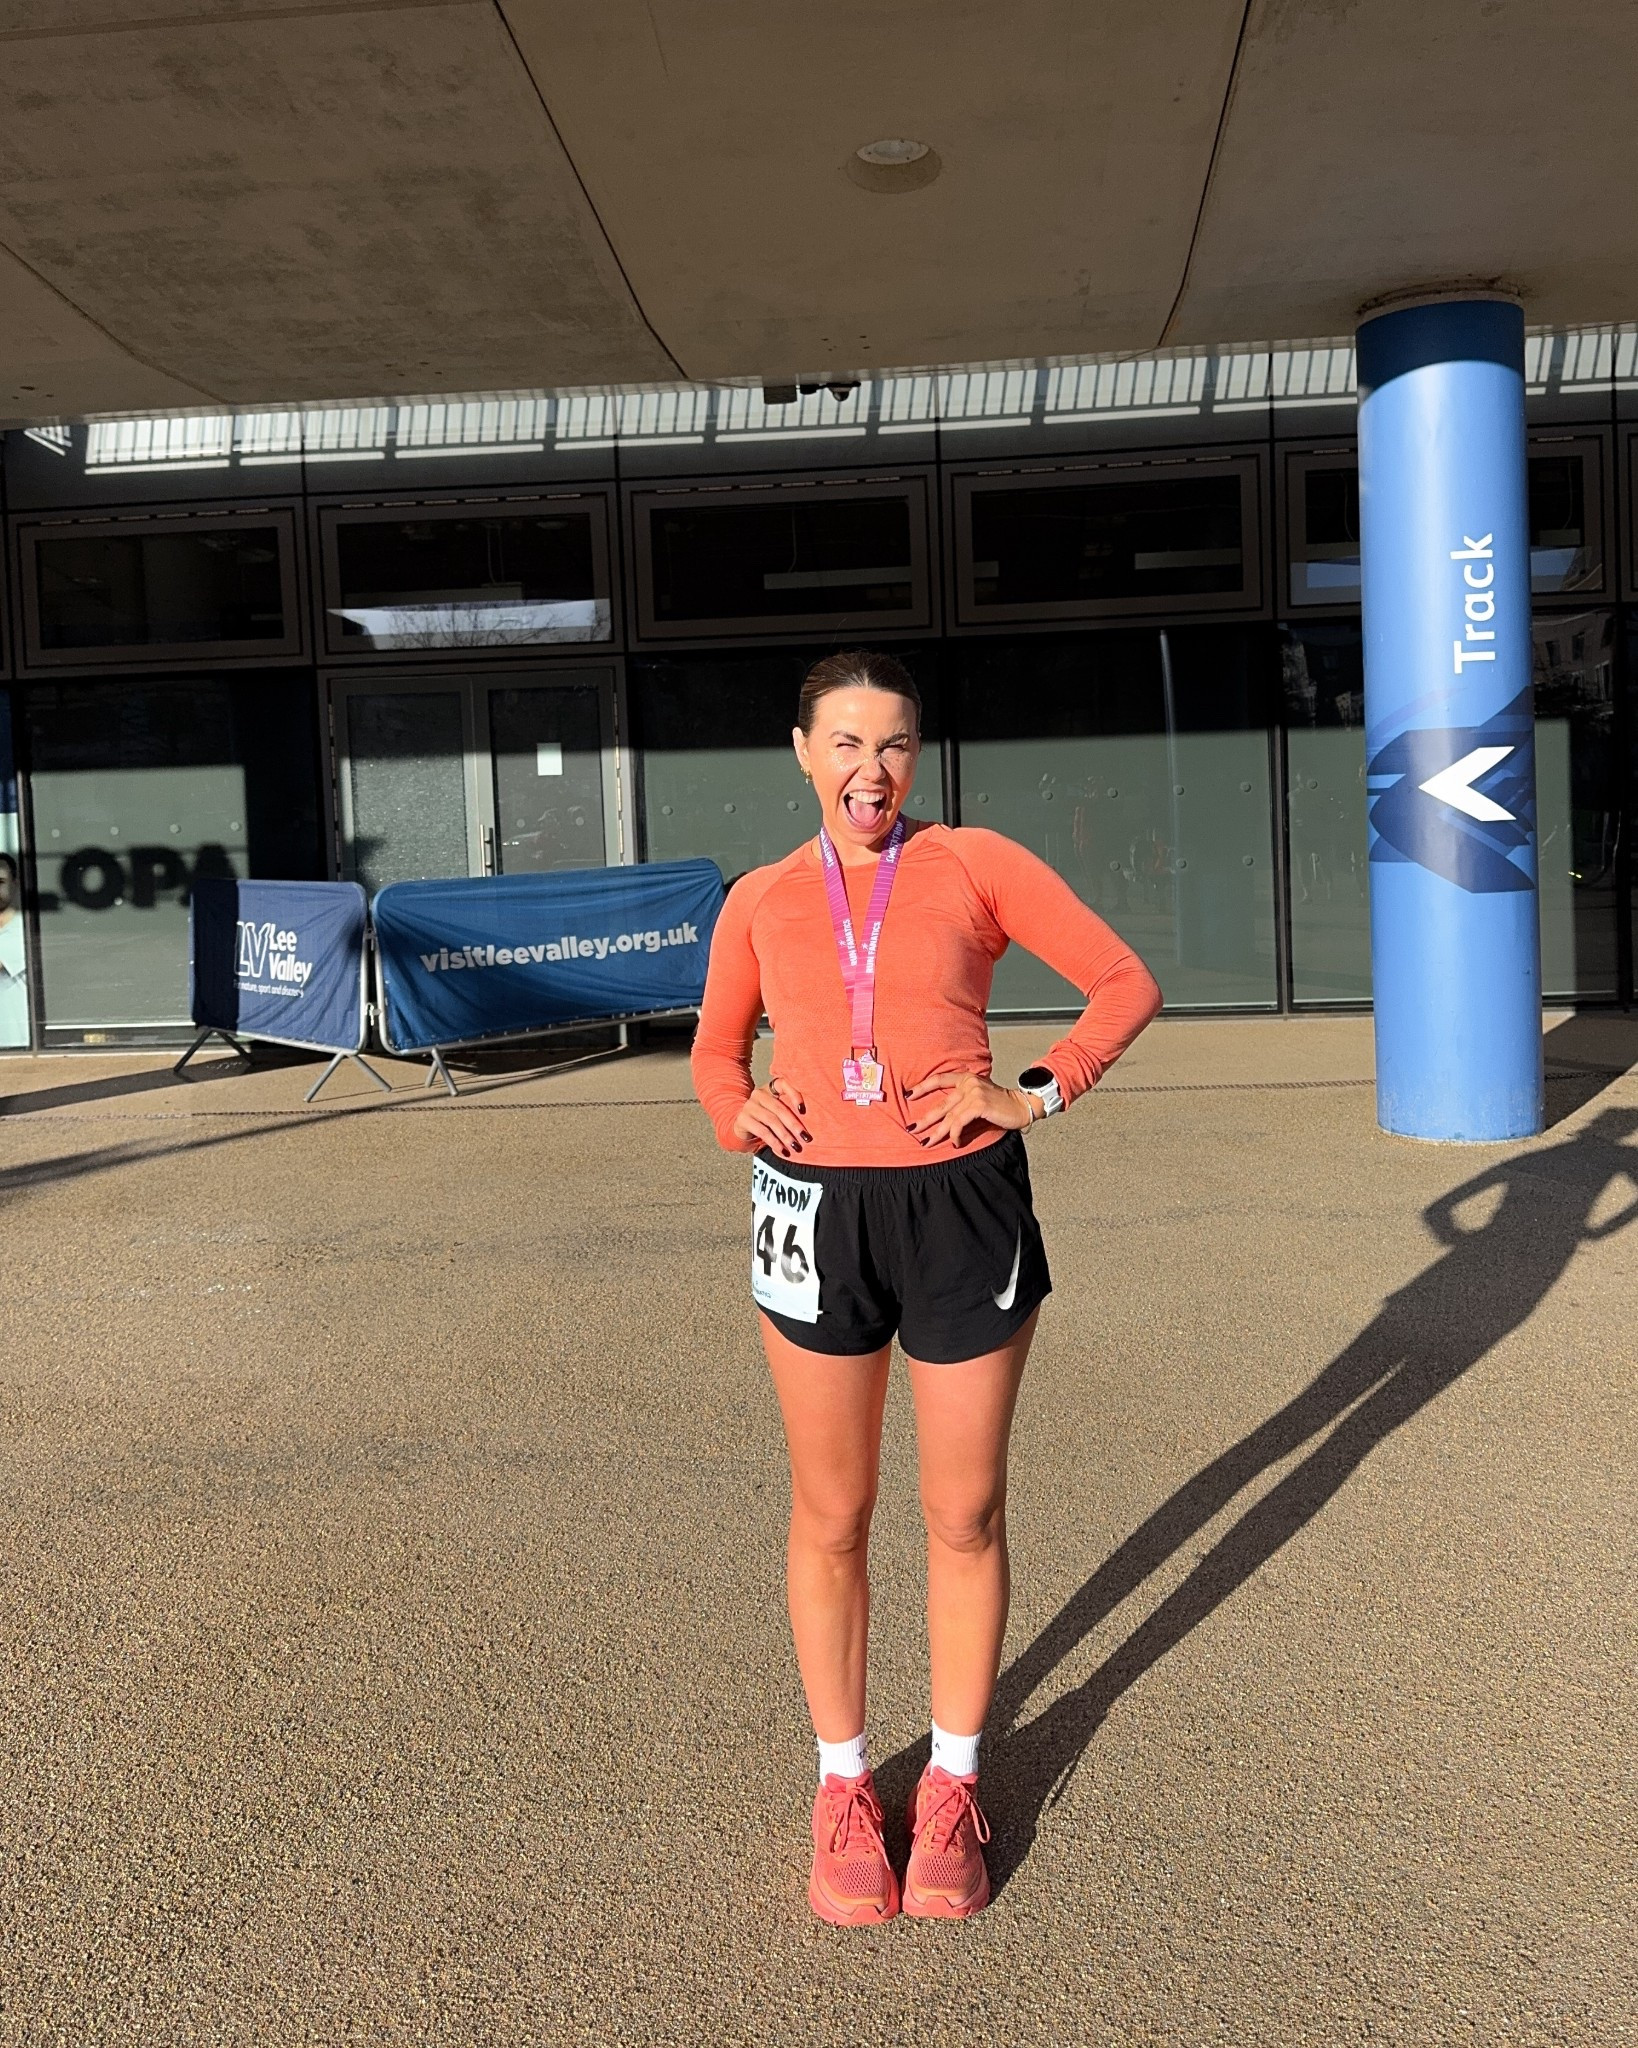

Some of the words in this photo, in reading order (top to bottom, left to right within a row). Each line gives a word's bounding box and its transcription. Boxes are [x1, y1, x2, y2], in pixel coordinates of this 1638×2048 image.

[1450, 533, 1495, 674] Track
[234, 920, 271, 978] LV
[269, 923, 297, 952] Lee
[420, 922, 698, 973] visitleevalley.org.uk
[843, 918, 857, 949] FANATICS
[868, 921, 881, 955] FANATICS
[269, 952, 313, 988] Valley
[849, 950, 858, 967] RUN
[866, 956, 875, 973] RUN
[752, 1201, 809, 1284] 46
